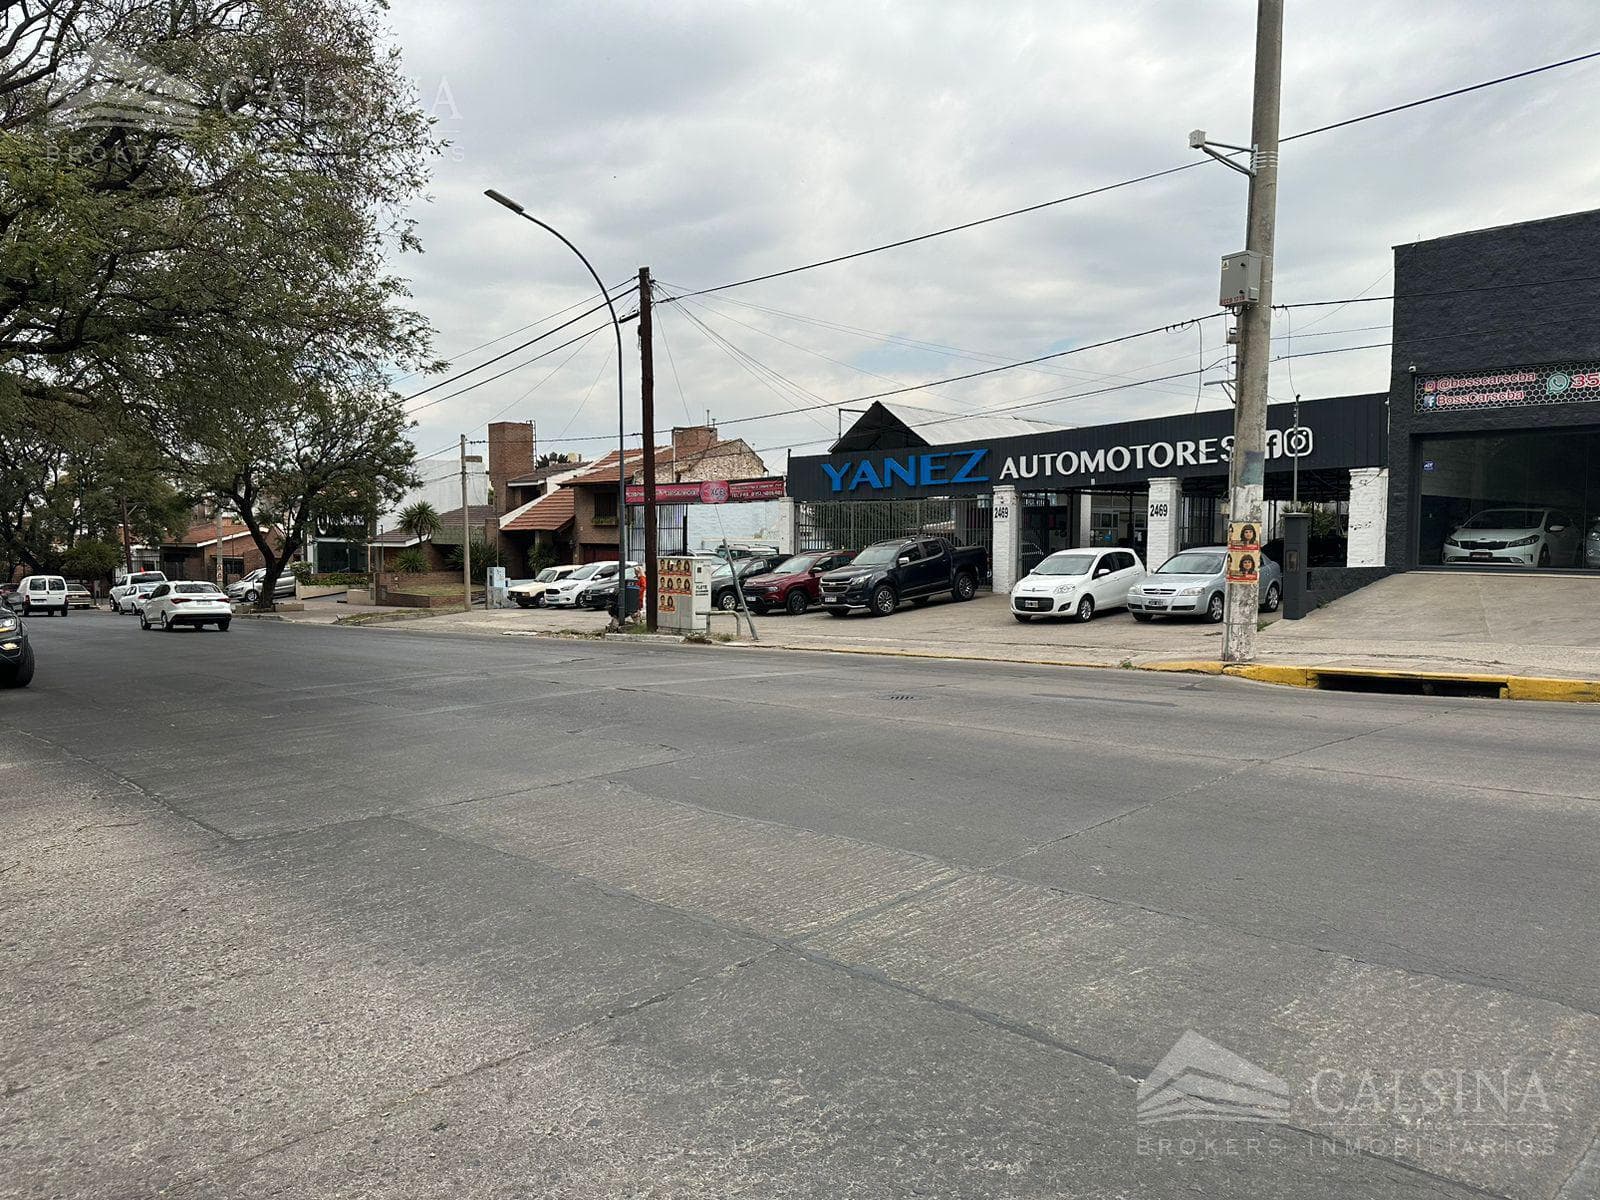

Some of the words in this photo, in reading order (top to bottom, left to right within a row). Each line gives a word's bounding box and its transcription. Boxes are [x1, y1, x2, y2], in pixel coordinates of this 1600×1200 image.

[1437, 372, 1536, 390] @bosscarscba
[1571, 373, 1600, 389] 35
[1437, 390, 1525, 406] BossCarscba
[821, 449, 990, 492] YANEZ
[999, 435, 1235, 480] AUTOMOTORES
[993, 506, 1010, 519] 2469
[1149, 504, 1168, 517] 2469
